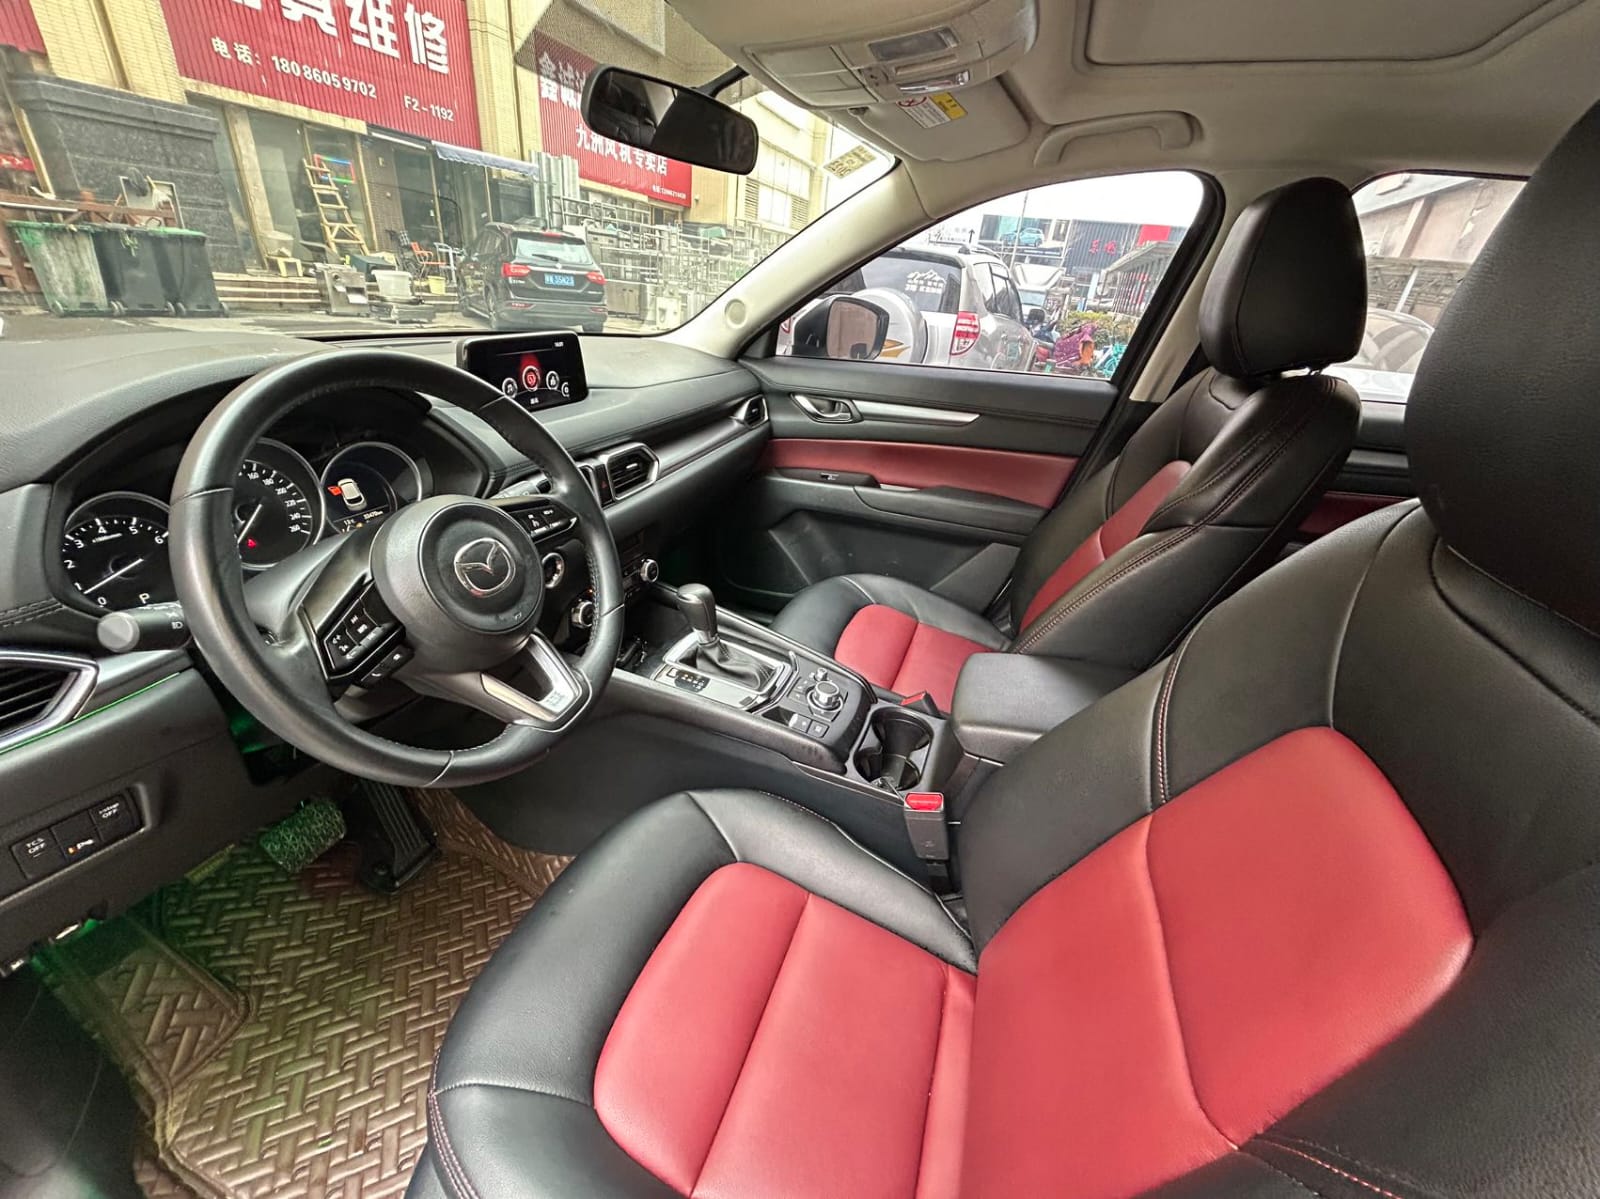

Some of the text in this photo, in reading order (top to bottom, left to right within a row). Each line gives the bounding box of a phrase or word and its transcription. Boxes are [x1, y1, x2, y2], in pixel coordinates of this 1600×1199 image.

[98, 526, 107, 534] 4
[129, 526, 138, 535] 5
[74, 539, 85, 549] 3
[154, 535, 164, 544] 6
[64, 559, 75, 569] 2
[139, 593, 150, 604] P
